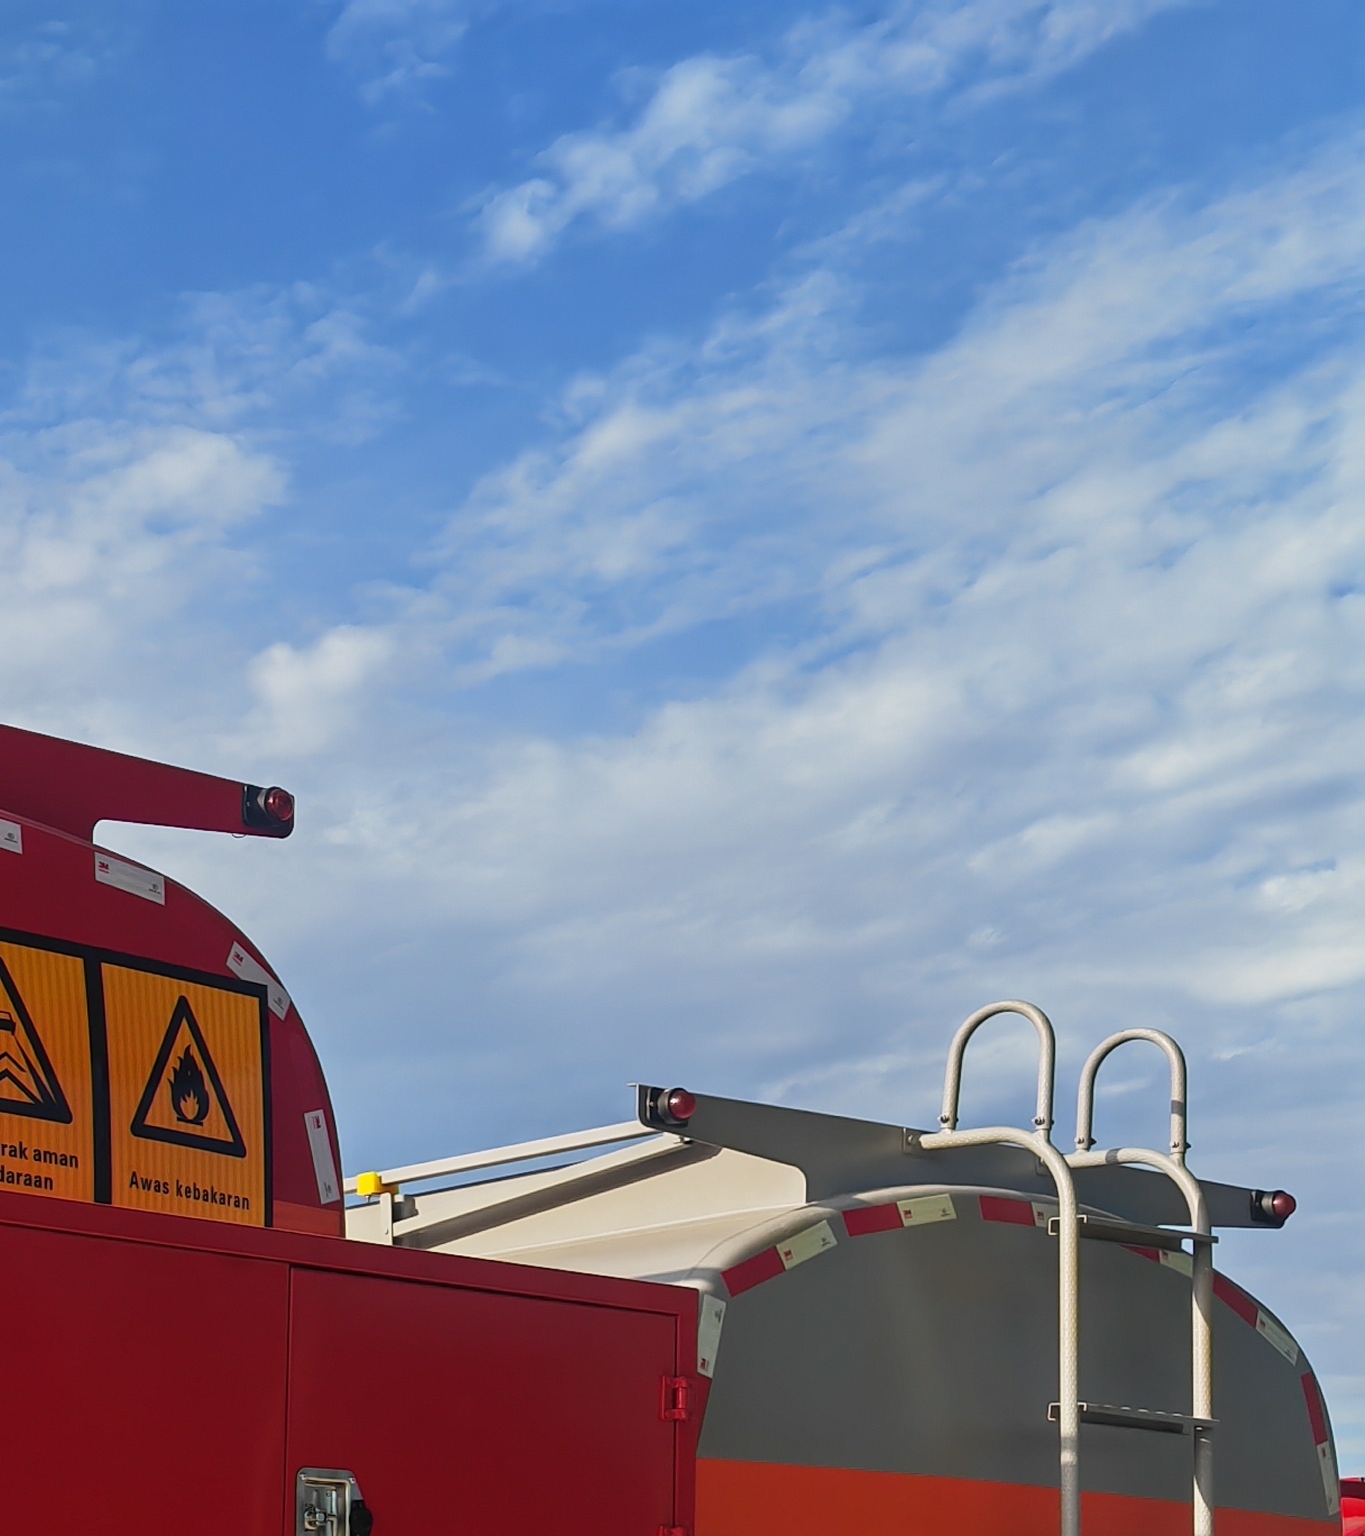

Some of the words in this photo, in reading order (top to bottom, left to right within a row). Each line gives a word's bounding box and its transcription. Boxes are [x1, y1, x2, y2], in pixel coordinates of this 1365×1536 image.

[33, 1147, 79, 1169] aman
[129, 1171, 169, 1195] Awas
[175, 1179, 249, 1211] kebakaran
